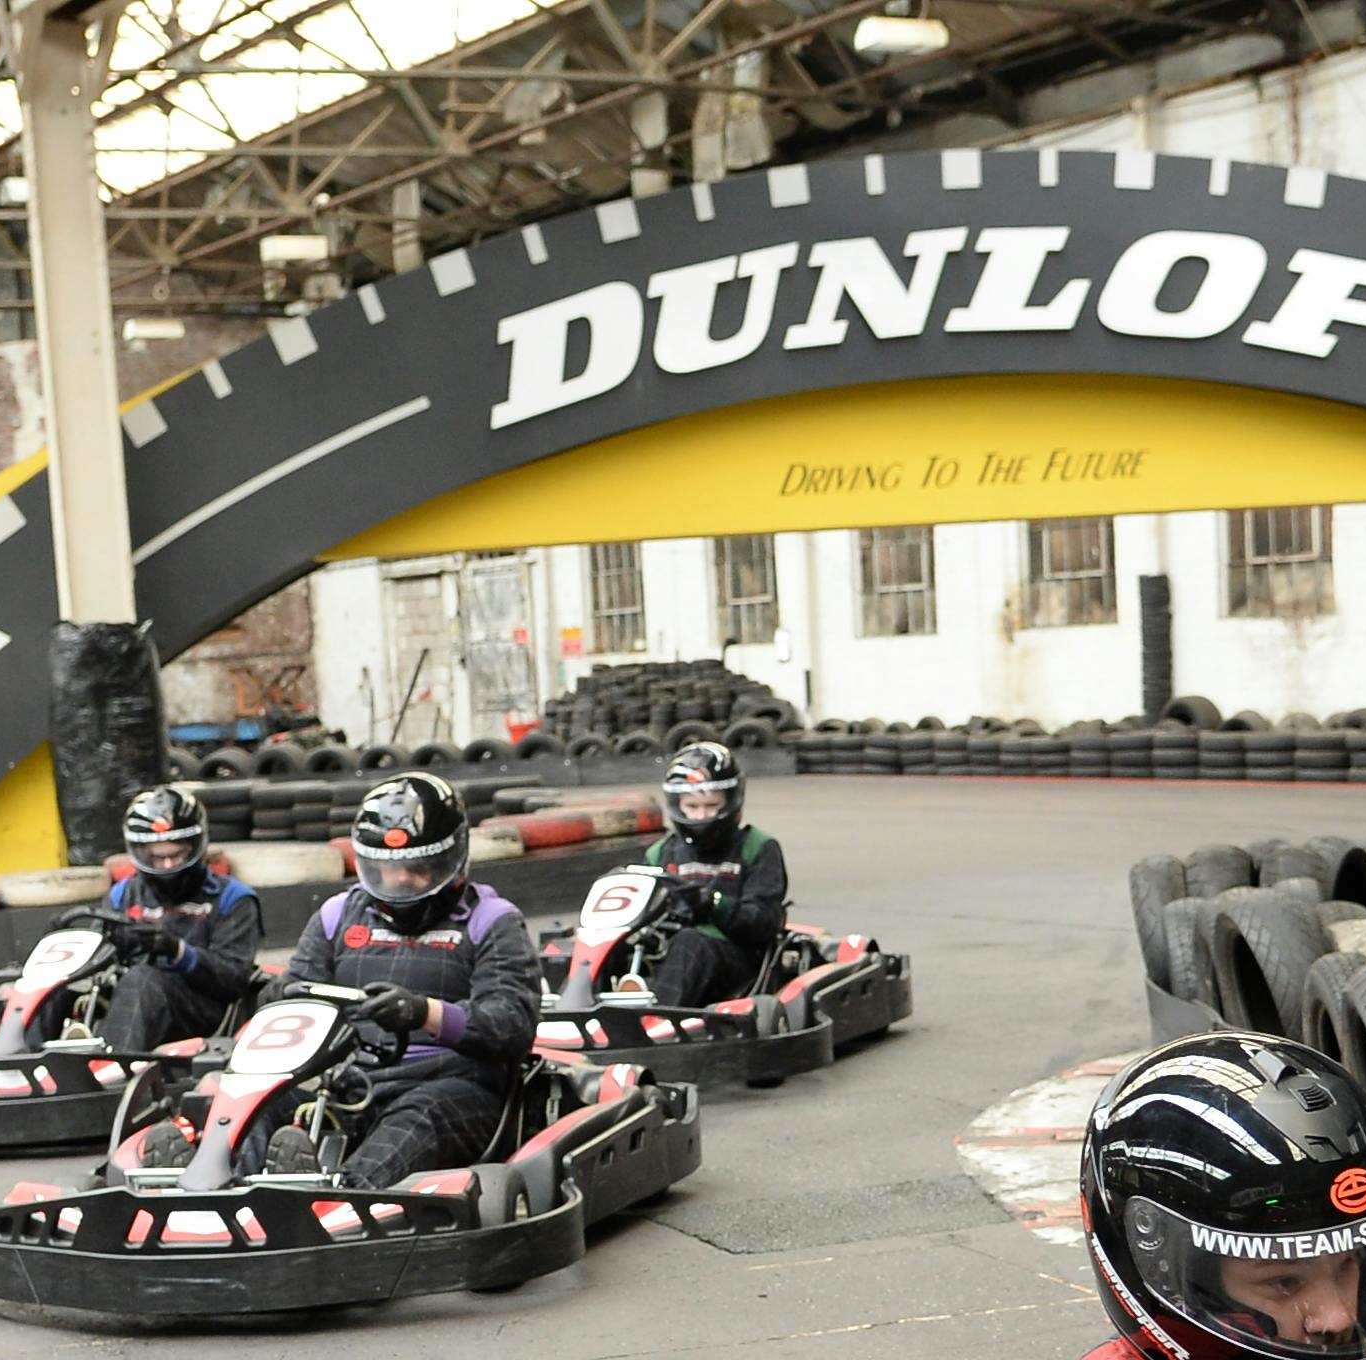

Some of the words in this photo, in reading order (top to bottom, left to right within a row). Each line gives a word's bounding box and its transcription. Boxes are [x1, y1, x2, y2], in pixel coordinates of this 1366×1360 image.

[592, 886, 639, 912] 6
[35, 941, 84, 966] 5
[247, 1015, 315, 1050] 8
